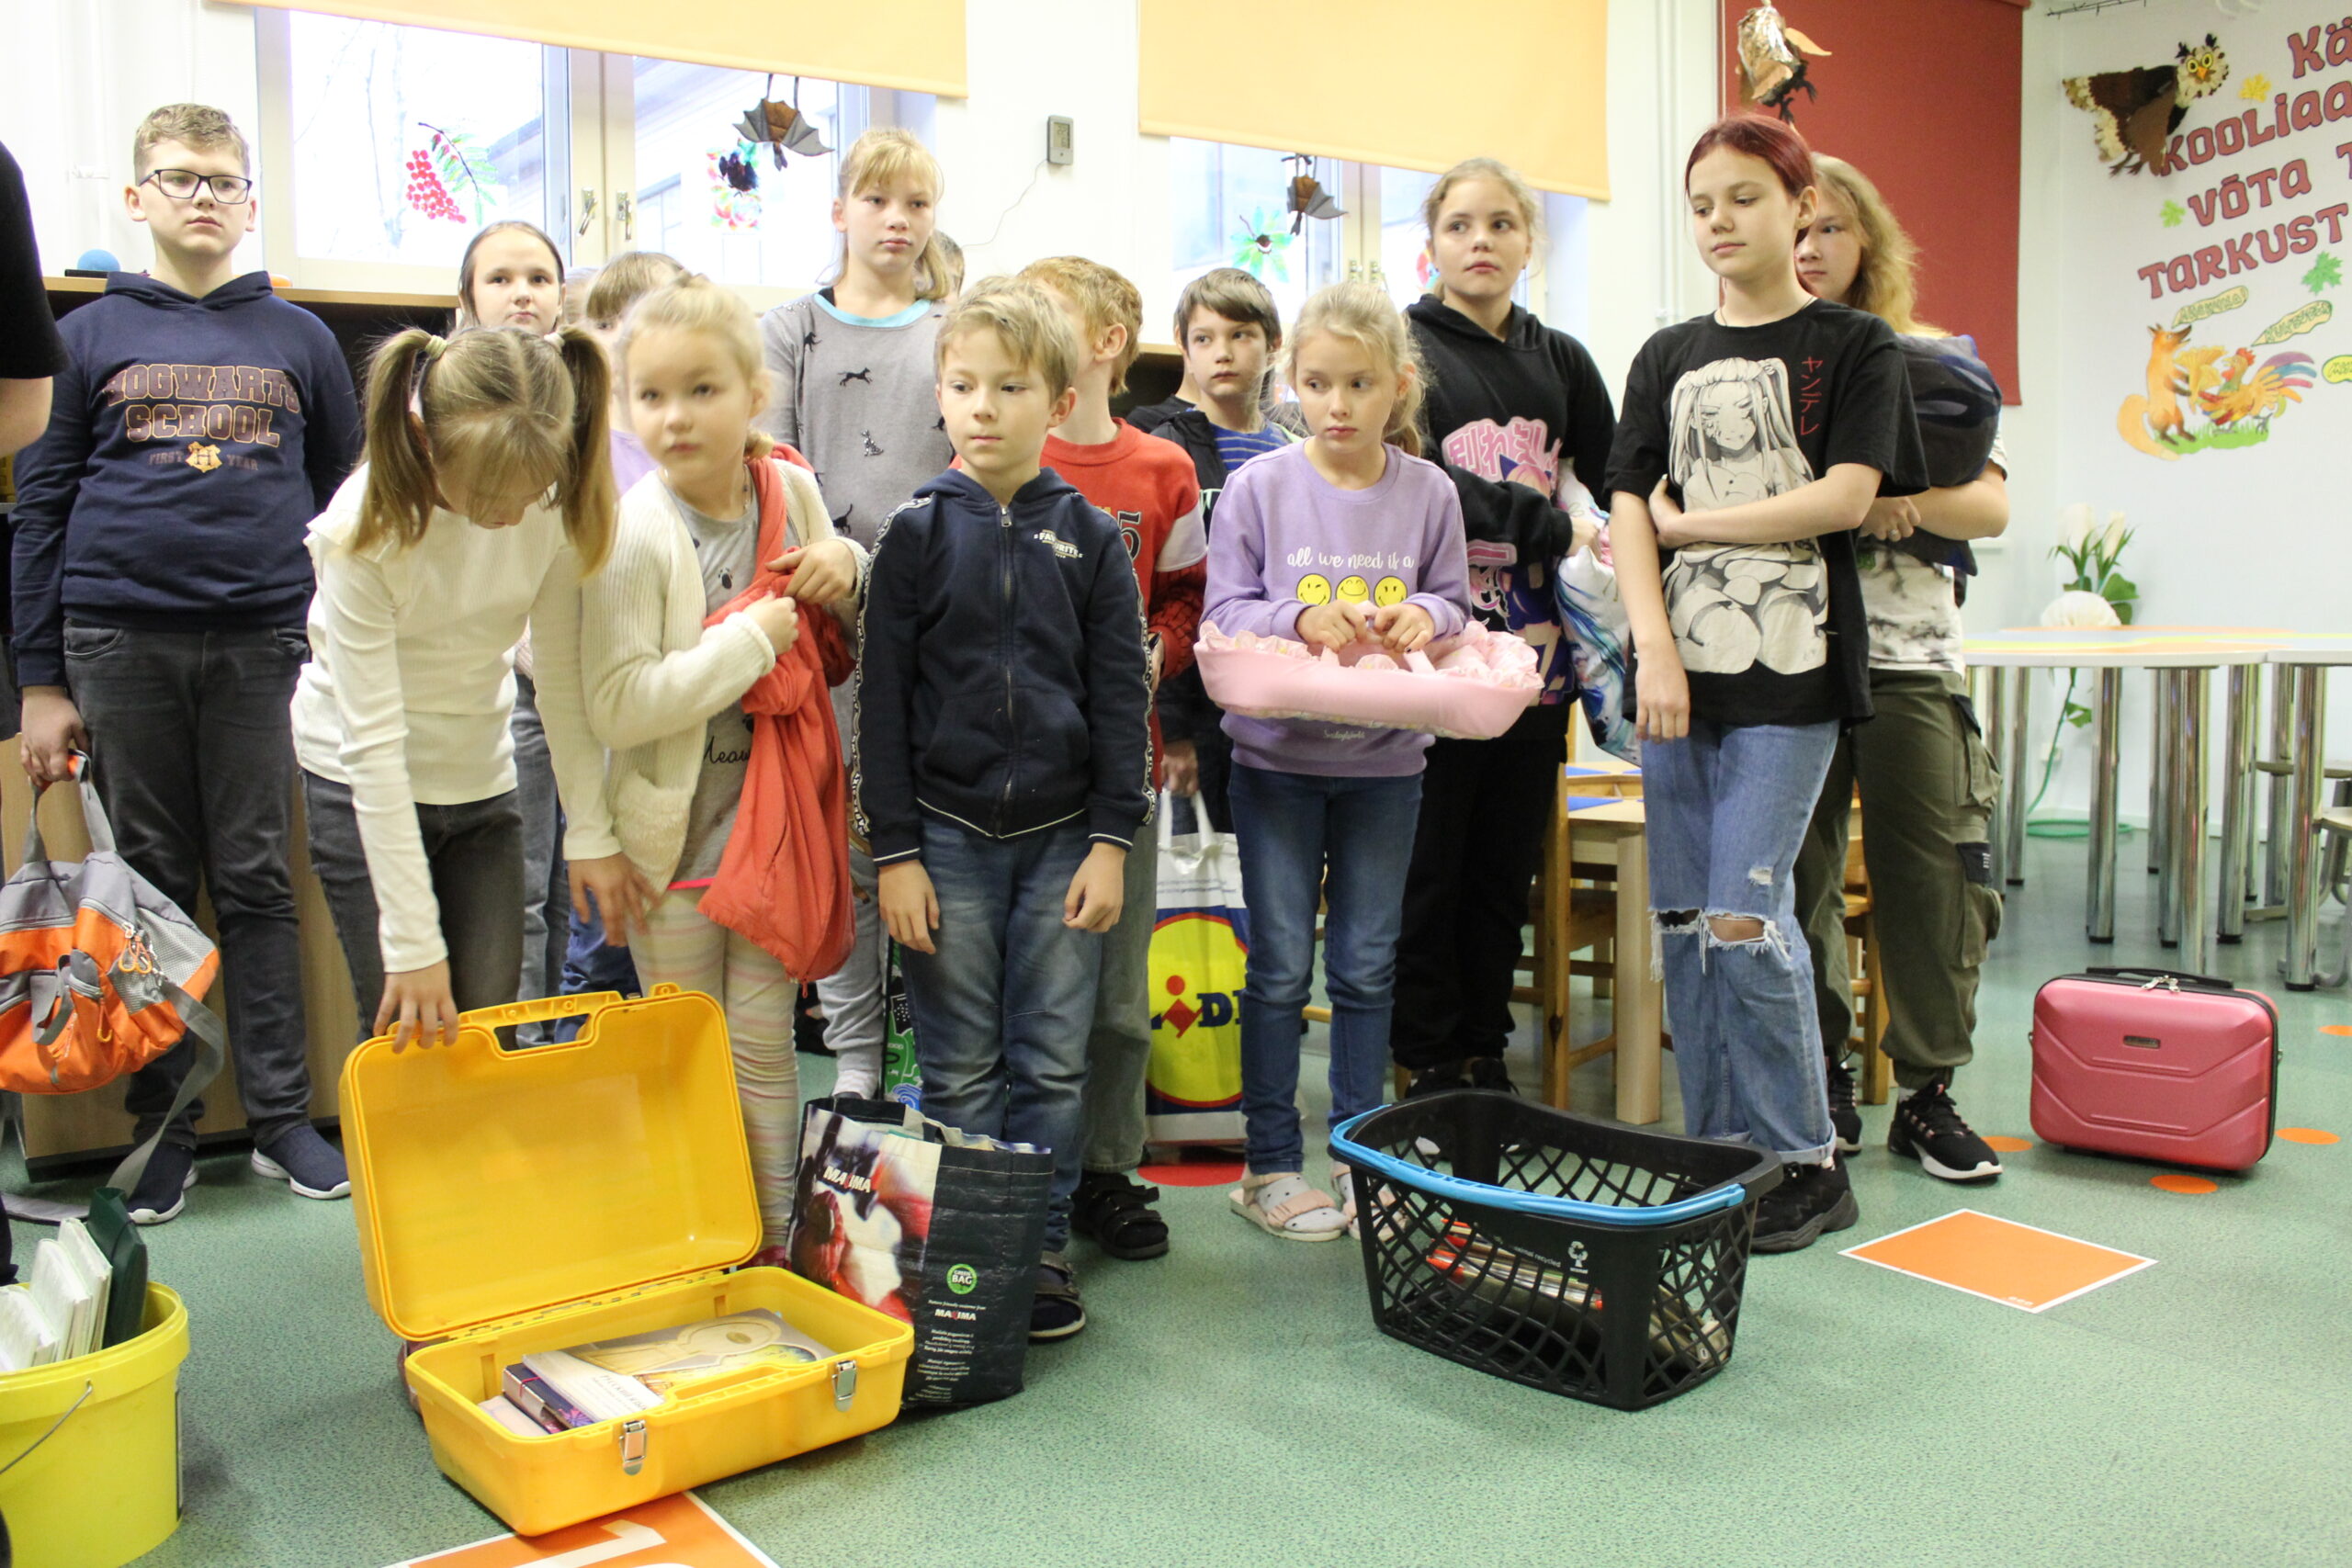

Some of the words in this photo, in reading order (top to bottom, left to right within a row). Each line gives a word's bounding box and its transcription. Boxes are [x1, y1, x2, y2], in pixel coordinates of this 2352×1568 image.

[2138, 203, 2348, 299] TARKUST
[126, 403, 280, 447] SCHOOL
[1287, 547, 1313, 568] all
[1318, 552, 1344, 568] we
[1348, 551, 1384, 570] need
[1403, 556, 1415, 569] a
[952, 1275, 972, 1285] BAG
